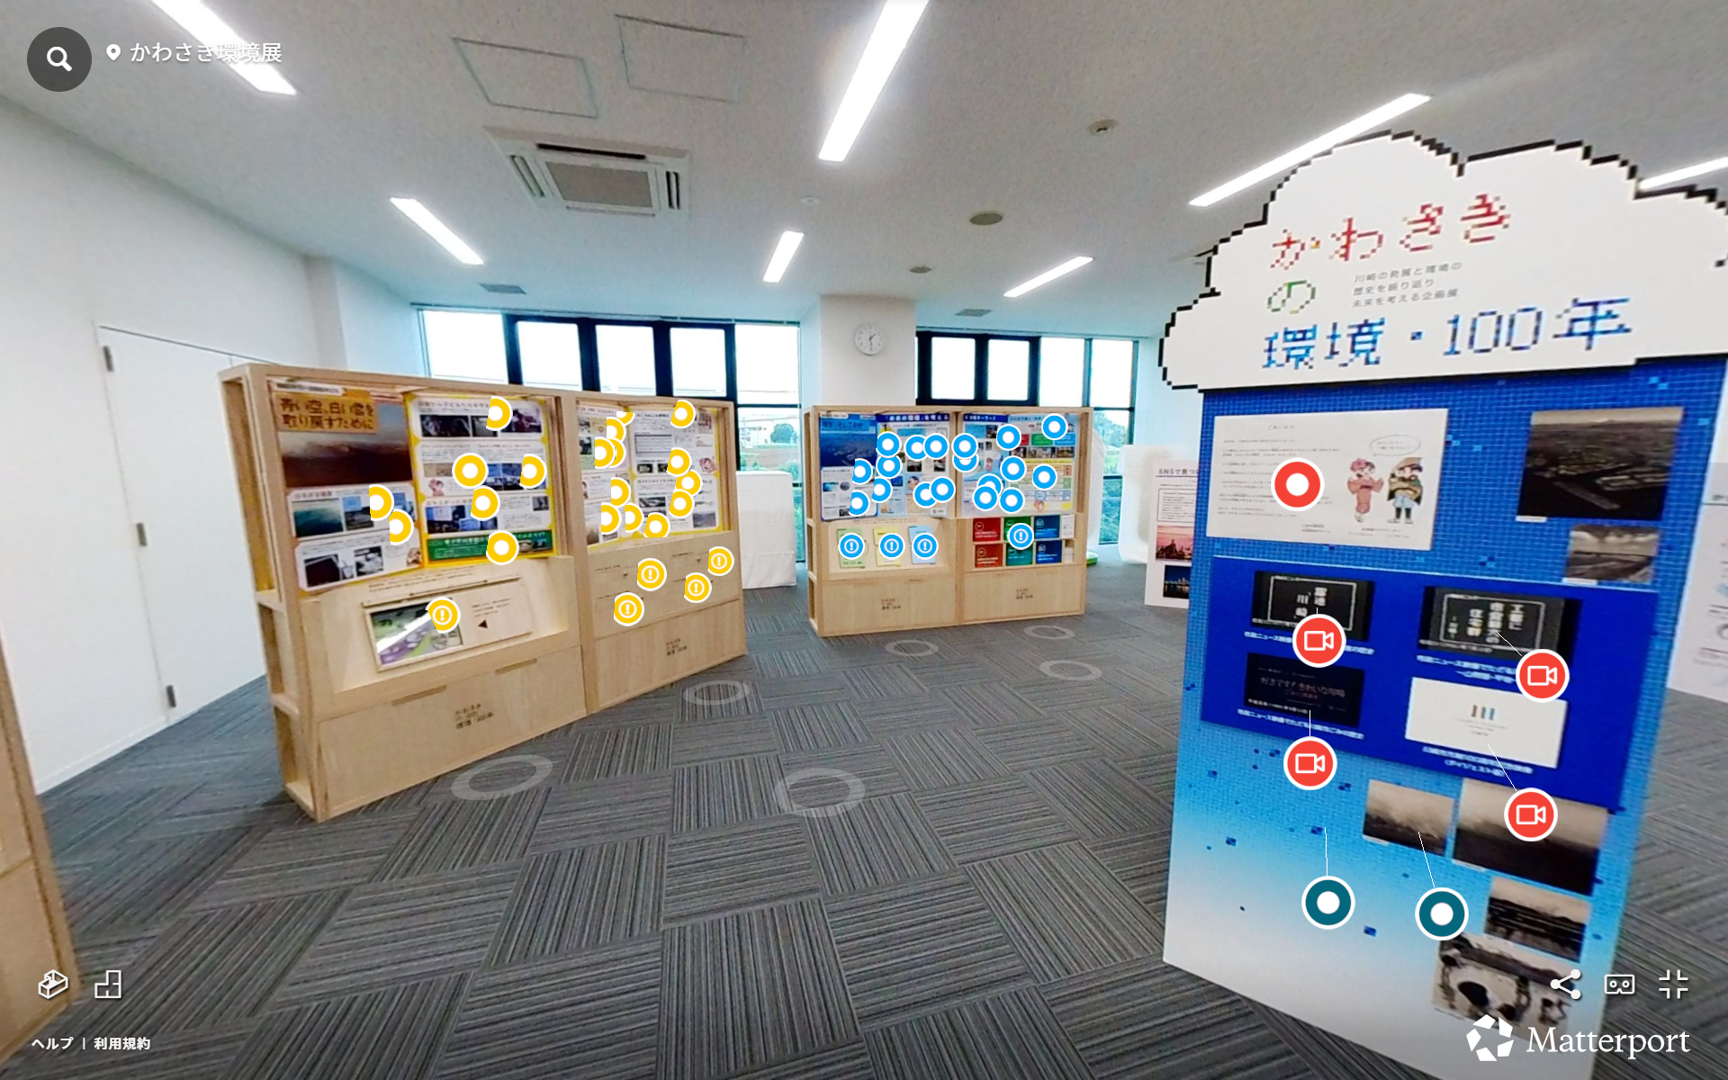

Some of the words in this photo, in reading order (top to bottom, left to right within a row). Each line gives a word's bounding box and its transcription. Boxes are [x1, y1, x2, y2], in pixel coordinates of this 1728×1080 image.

[1270, 193, 1512, 270] かわさき
[1267, 279, 1316, 315] の
[1352, 288, 1459, 308] 未来を考える企画展
[1261, 297, 1633, 371] 環境・100年
[281, 413, 374, 430] 取り戻すために
